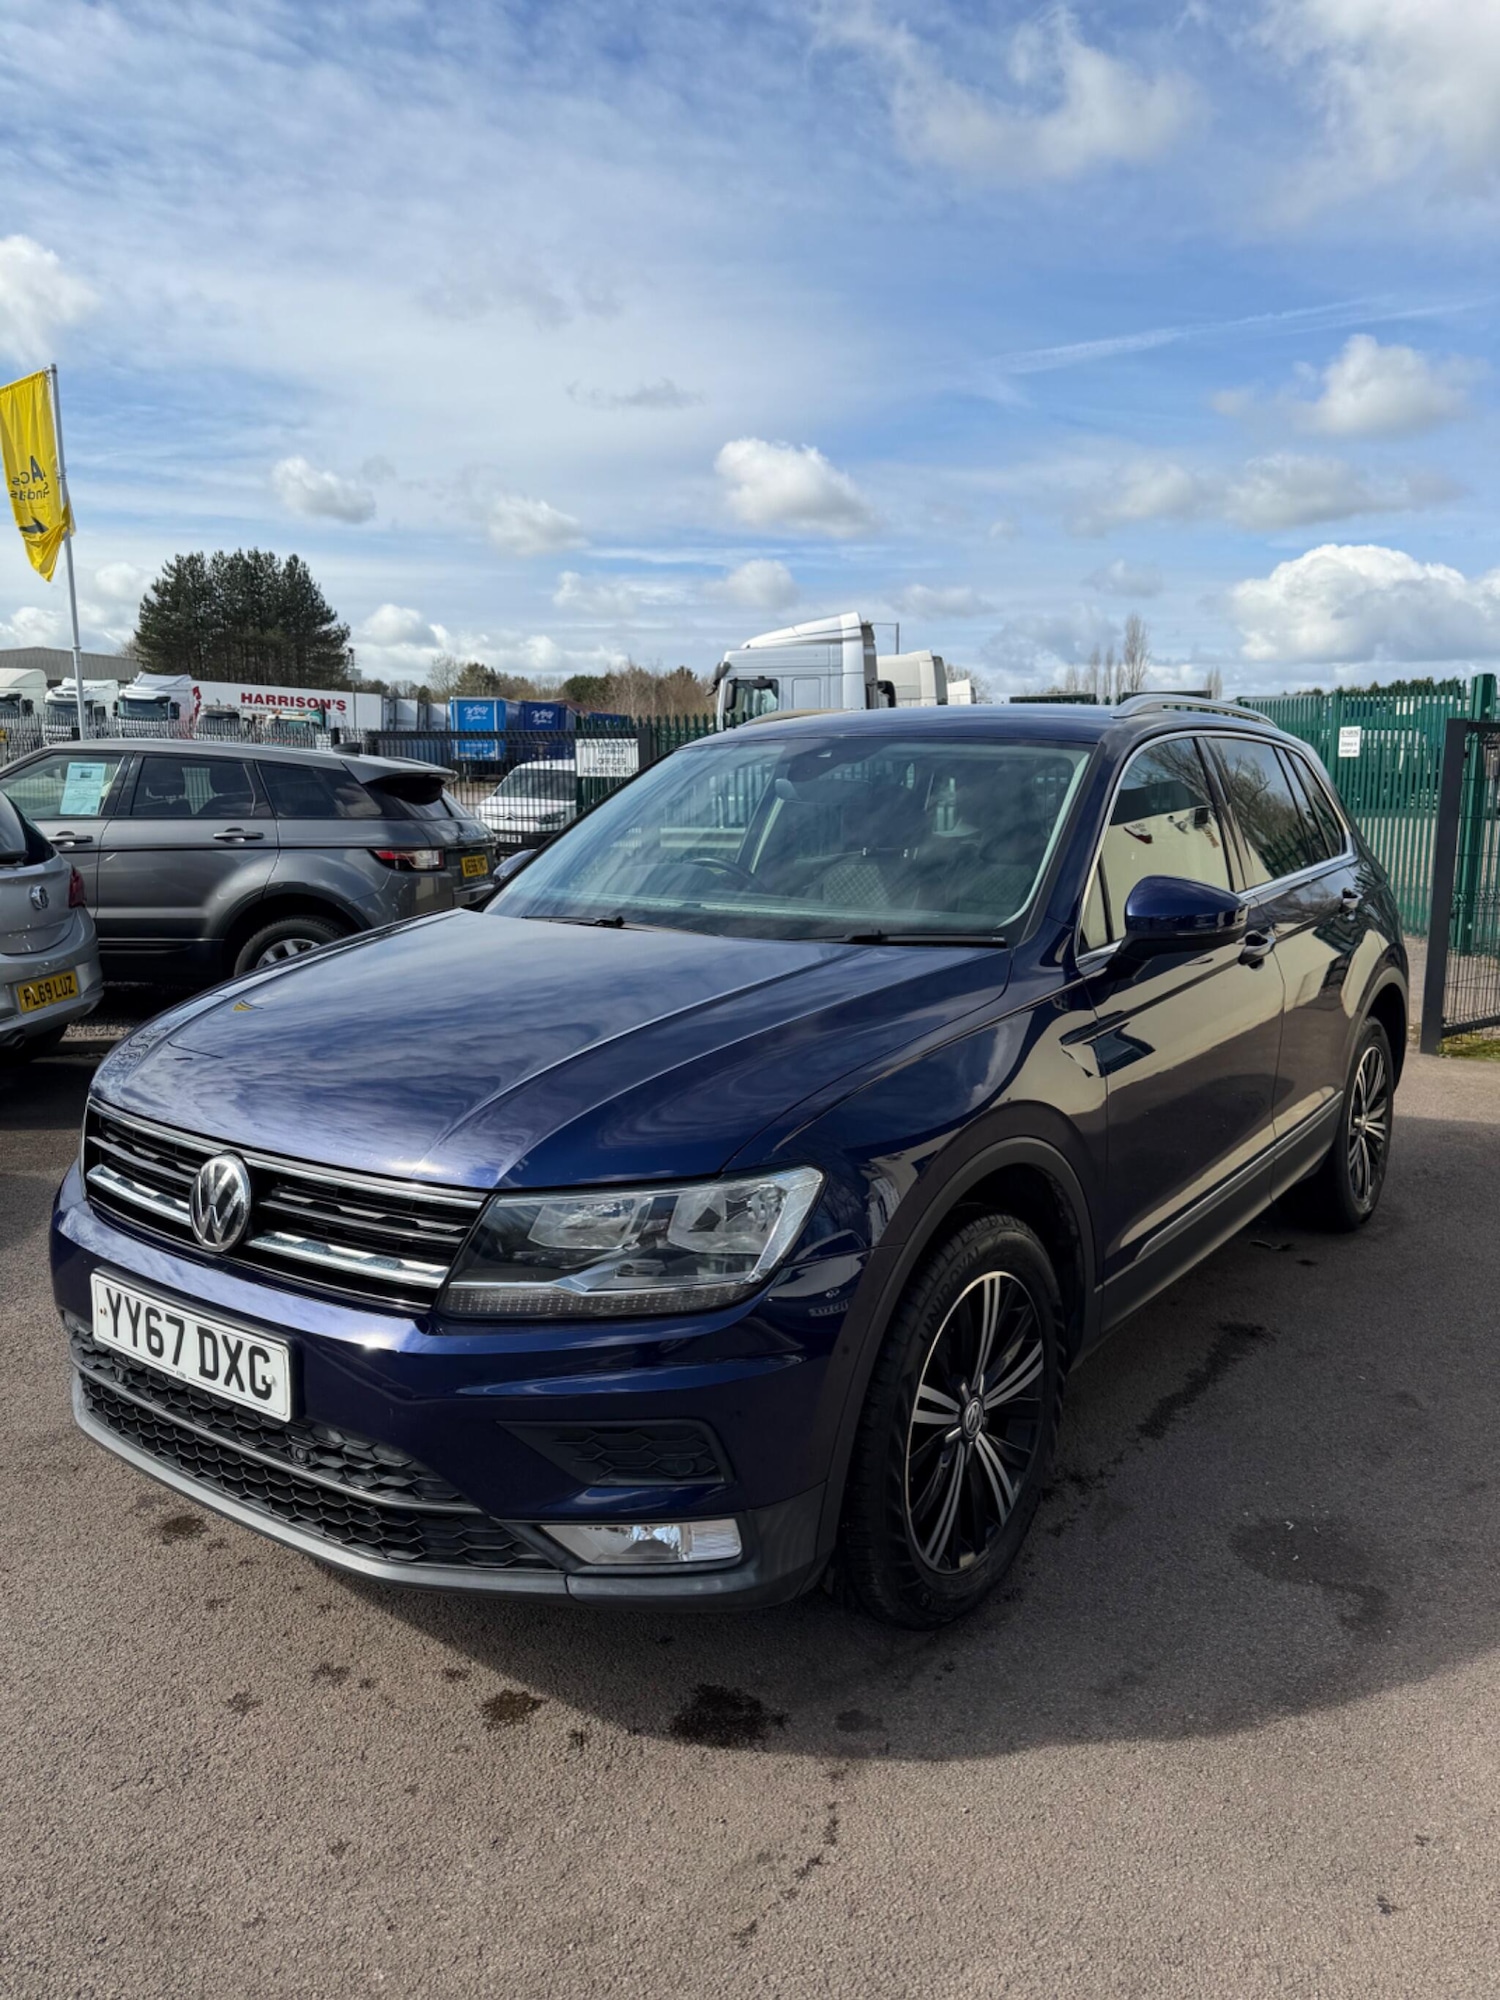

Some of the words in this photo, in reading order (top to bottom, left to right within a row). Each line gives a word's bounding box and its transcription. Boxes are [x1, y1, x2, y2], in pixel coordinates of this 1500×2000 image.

[240, 692, 347, 711] HARRISON'S
[23, 982, 53, 1008] FL69
[53, 975, 75, 999] LUZ
[919, 1246, 980, 1342] UNIROYAL
[105, 1287, 185, 1366] YY67
[196, 1325, 273, 1401] DXG
